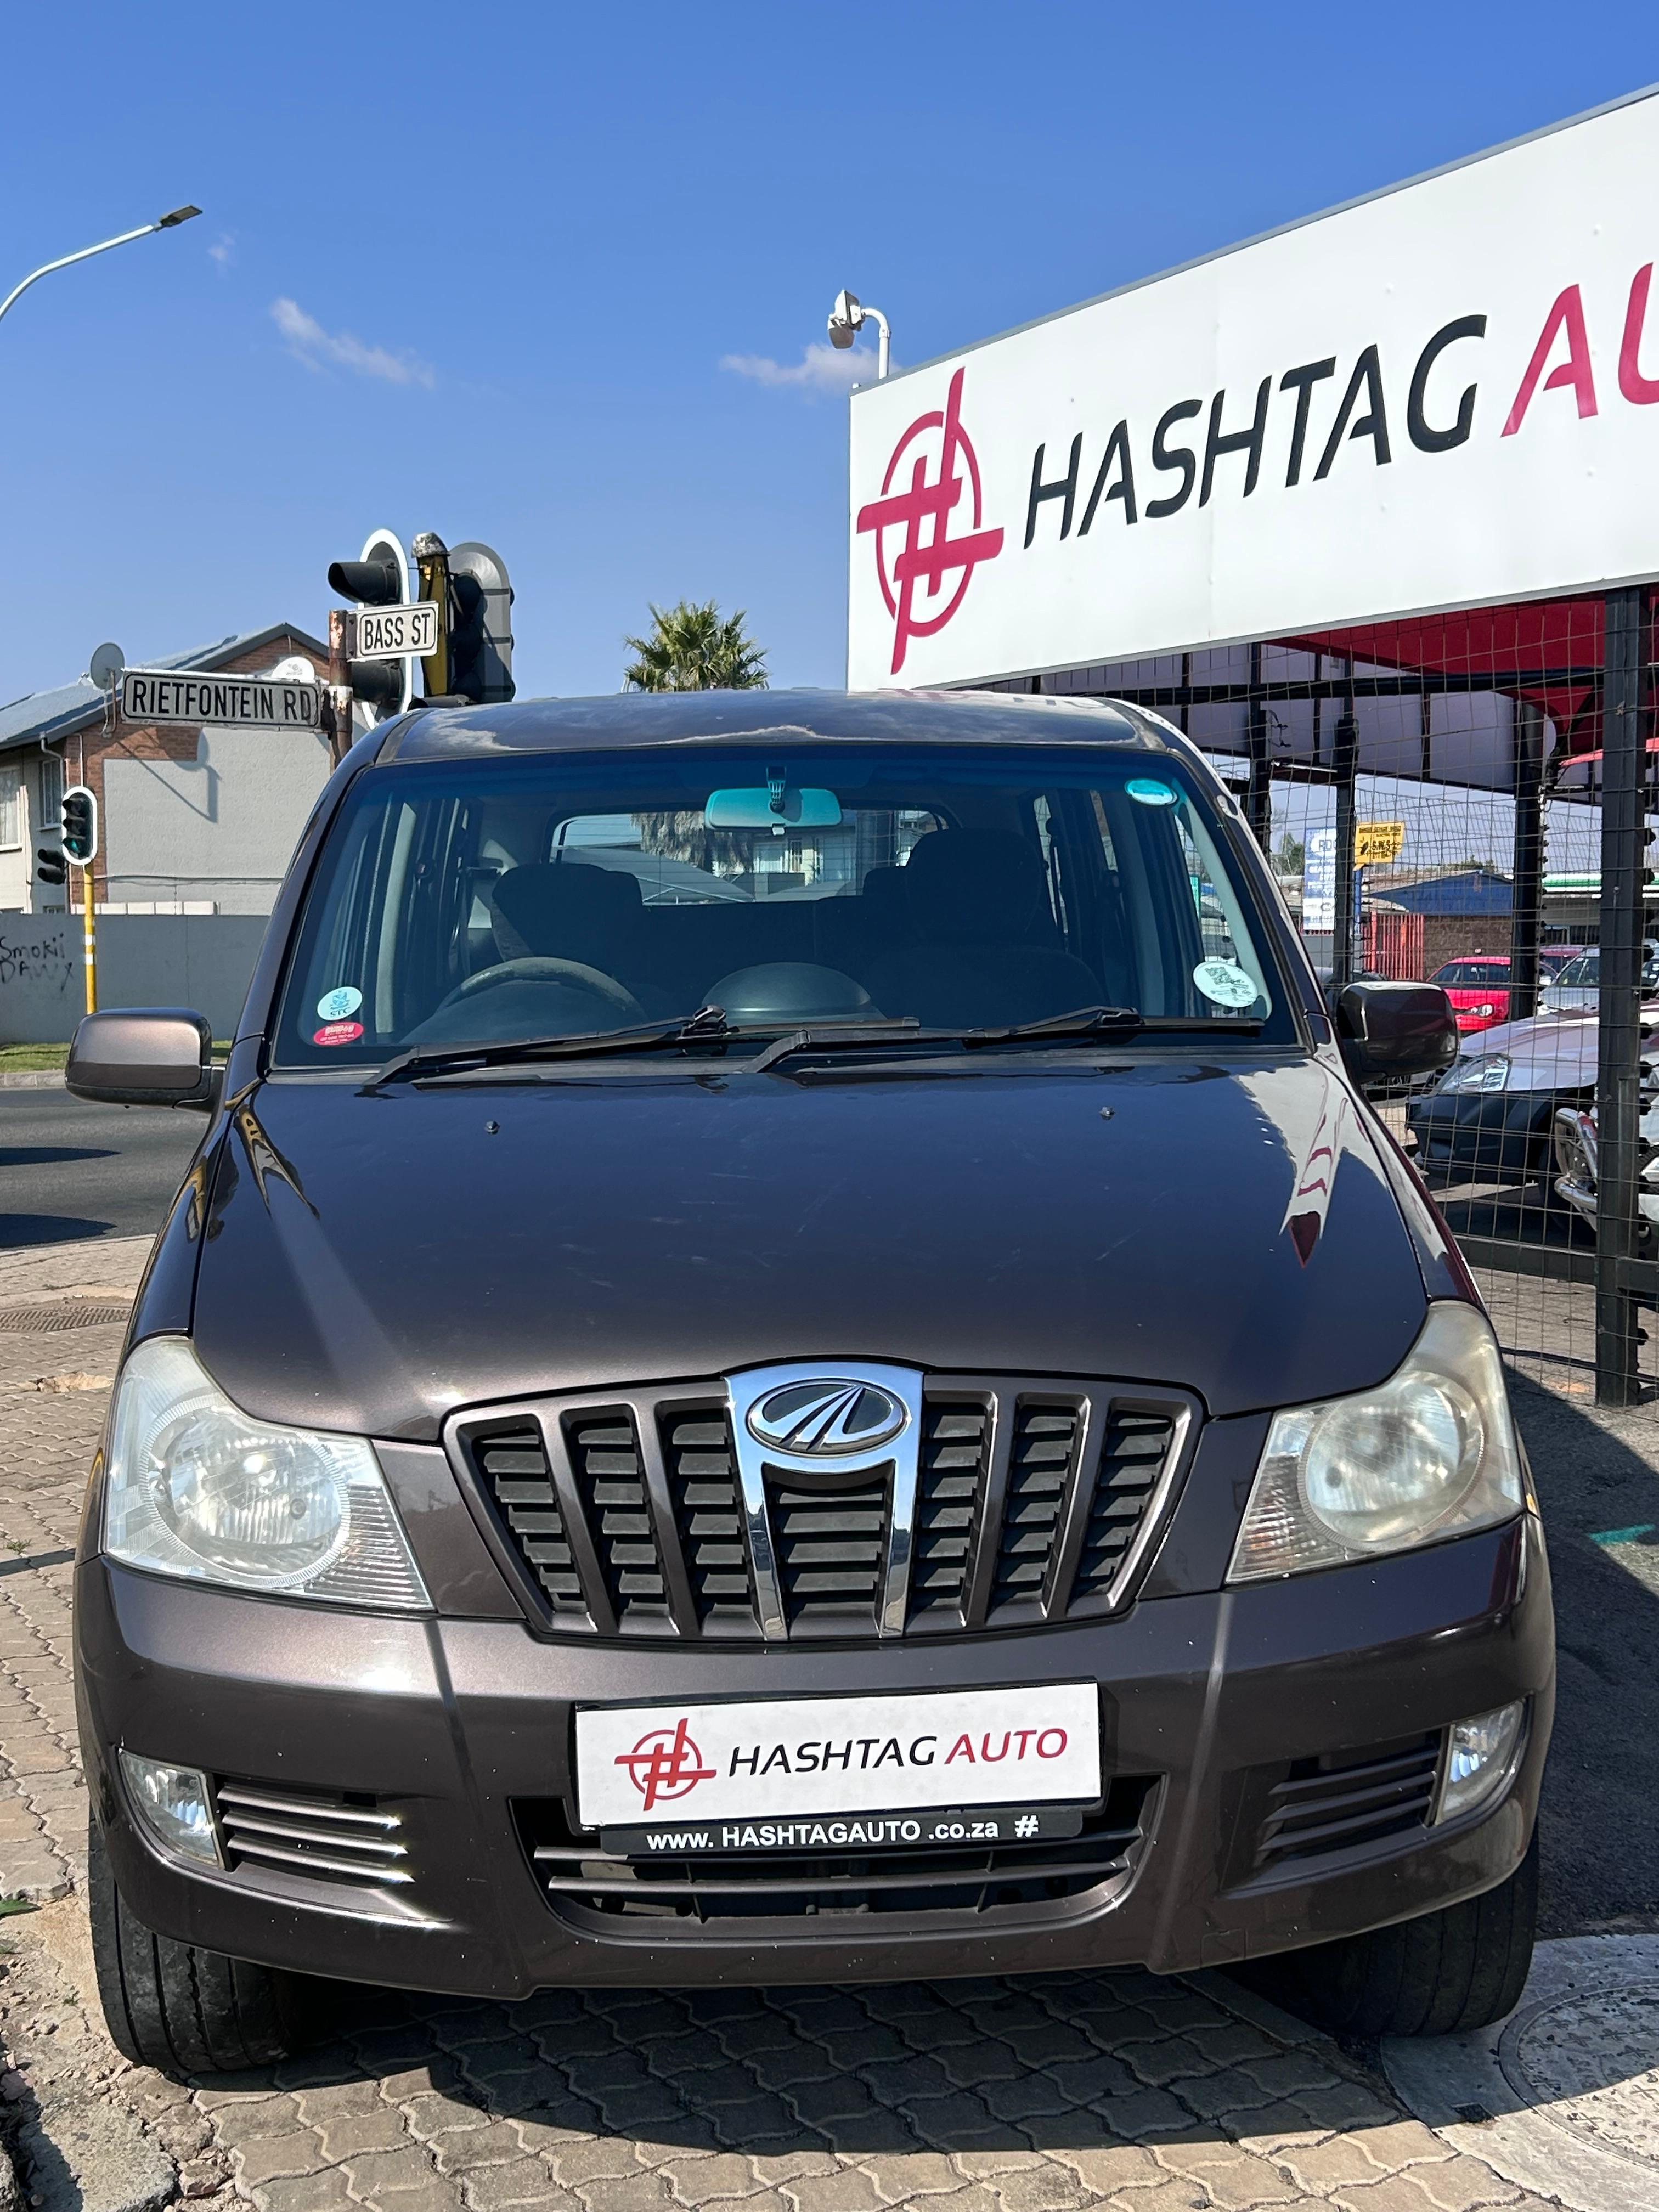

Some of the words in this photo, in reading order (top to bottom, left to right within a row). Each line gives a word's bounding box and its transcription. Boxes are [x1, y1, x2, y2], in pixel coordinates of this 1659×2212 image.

[1024, 314, 1488, 549] HASHTAG
[365, 616, 404, 650] BASS
[411, 613, 431, 645] ST
[132, 680, 274, 720] RIETFONTEIN
[283, 689, 311, 722] RD
[729, 1736, 938, 1777] HASHTAG
[945, 1728, 1068, 1764] AUTO
[646, 1832, 714, 1850] www.
[722, 1820, 921, 1847] HASHTAGAUTO
[928, 1822, 998, 1840] .co.za
[1014, 1815, 1039, 1837] #
